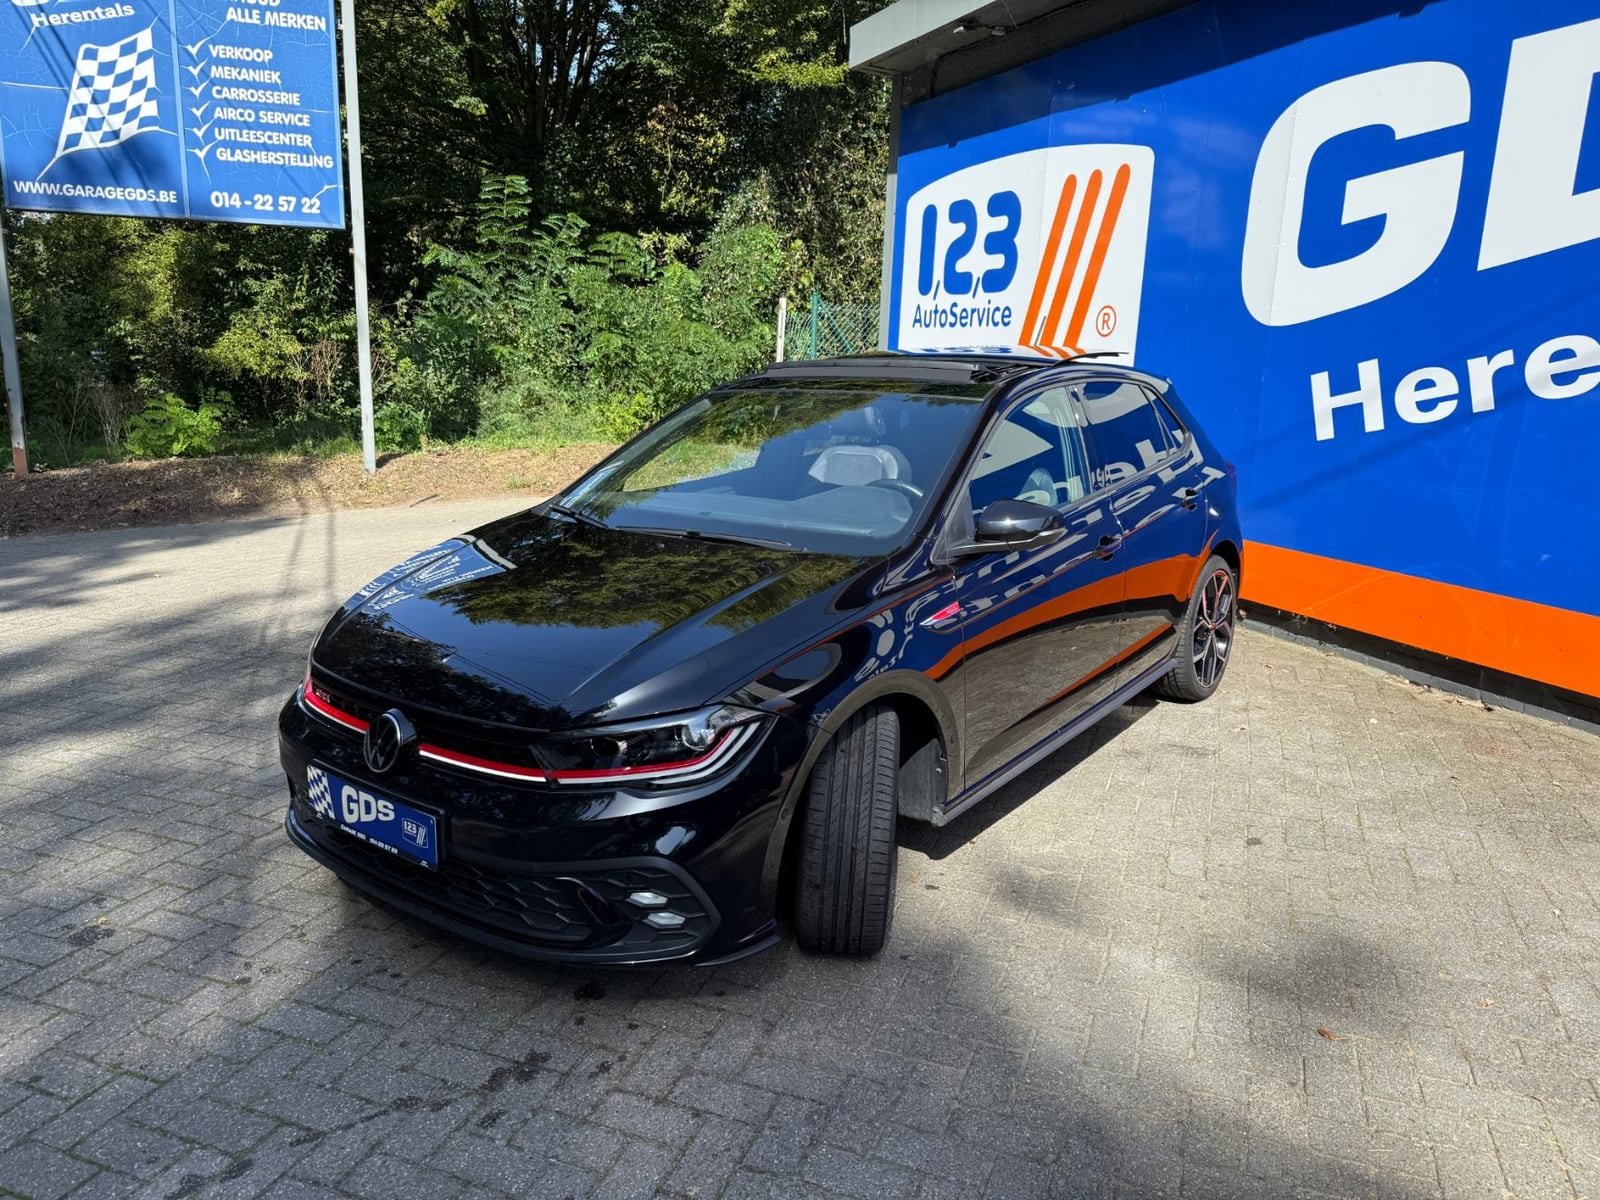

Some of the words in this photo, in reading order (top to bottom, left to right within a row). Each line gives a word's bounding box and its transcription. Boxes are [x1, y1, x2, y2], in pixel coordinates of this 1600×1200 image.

[30, 2, 136, 27] Herentals
[226, 7, 261, 24] ALLE
[264, 11, 327, 32] MERKEN
[208, 44, 274, 62] VERKOOP
[210, 65, 282, 84] MEKANIEK
[211, 86, 301, 106] CARROSSERIE
[213, 107, 256, 122] AIRCO
[258, 110, 311, 127] SERVICE
[214, 127, 313, 147] UITLEESCENTER
[215, 147, 335, 169] GLASHERSTELLING
[13, 180, 179, 203] WWW.GARAGEGDS.BE
[210, 190, 242, 209] 014
[253, 193, 274, 211] 22
[278, 195, 297, 213] 57
[301, 196, 322, 215] 22
[912, 299, 1012, 329] AutoService
